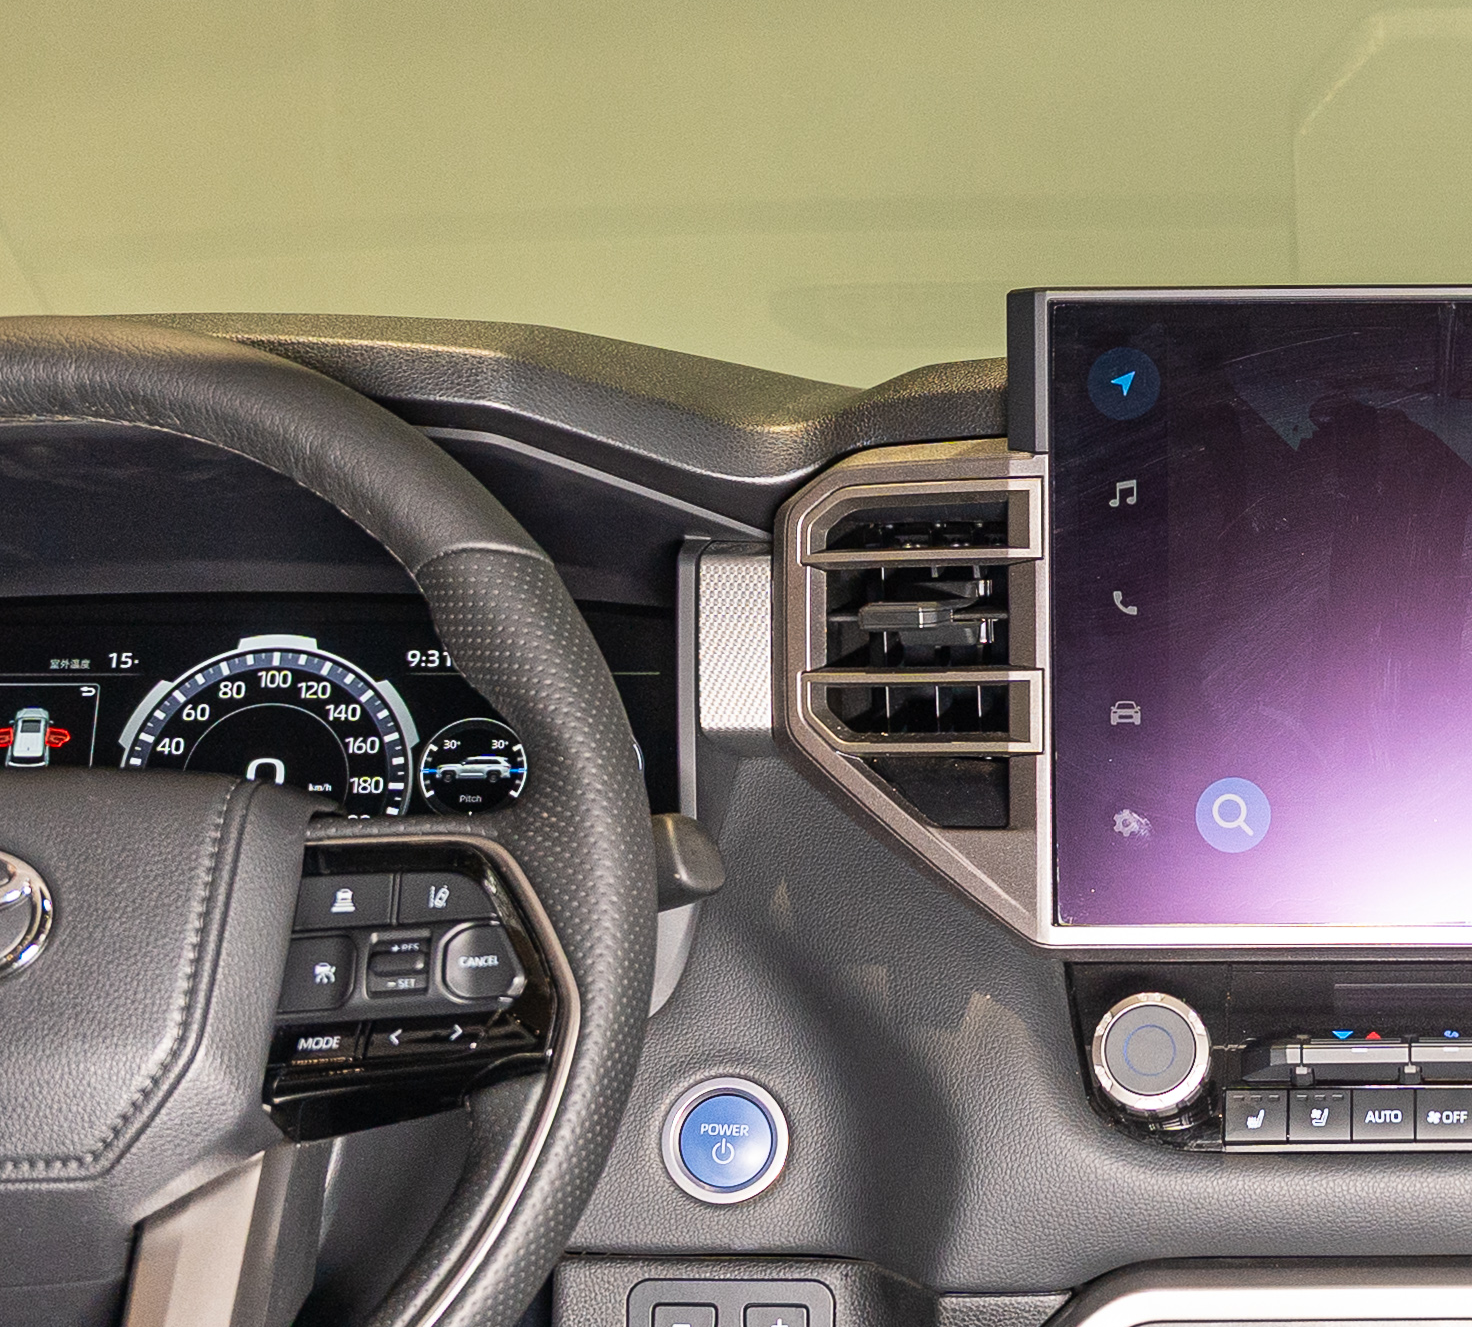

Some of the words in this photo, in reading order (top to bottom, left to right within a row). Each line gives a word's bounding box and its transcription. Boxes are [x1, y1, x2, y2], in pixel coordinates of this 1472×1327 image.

[257, 671, 292, 688] 100
[218, 681, 246, 698] 80
[297, 681, 331, 699] 120
[182, 703, 210, 721] 60
[325, 704, 361, 722] 140
[156, 737, 185, 755] 40
[345, 736, 379, 754] 160
[308, 783, 332, 792] km/h
[350, 777, 384, 794] 180
[459, 795, 482, 804] Pitch
[458, 955, 499, 967] CANCEL
[297, 1036, 341, 1051] MODE
[1365, 1109, 1402, 1124] AUTO
[1442, 1111, 1468, 1124] OFF
[700, 1124, 750, 1138] POWER
